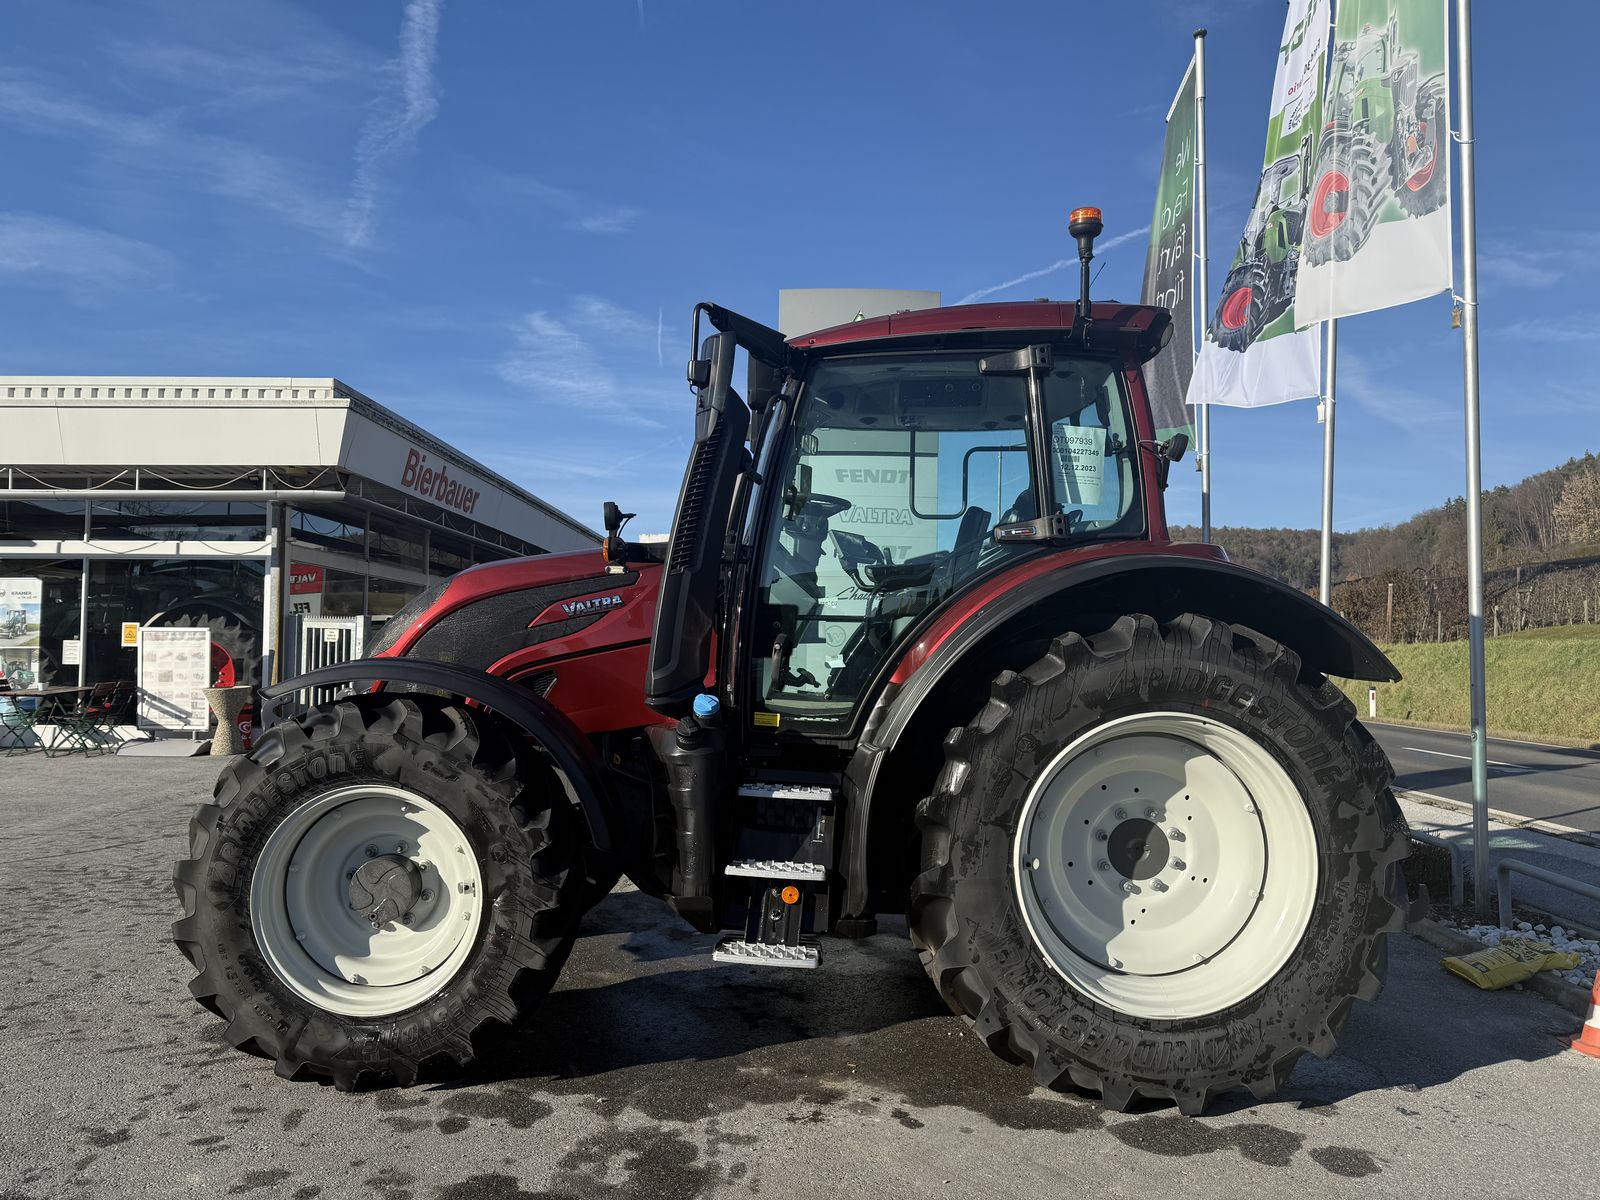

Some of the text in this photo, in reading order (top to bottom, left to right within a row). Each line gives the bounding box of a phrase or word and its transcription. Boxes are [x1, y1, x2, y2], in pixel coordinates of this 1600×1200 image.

[401, 447, 480, 514] Bierbauer
[835, 469, 911, 484] FENDT
[840, 505, 914, 526] VALTRA
[562, 594, 625, 618] VALTRA
[1106, 665, 1345, 787] BRIDGESTONE
[206, 748, 367, 888] BRIDGESTONE
